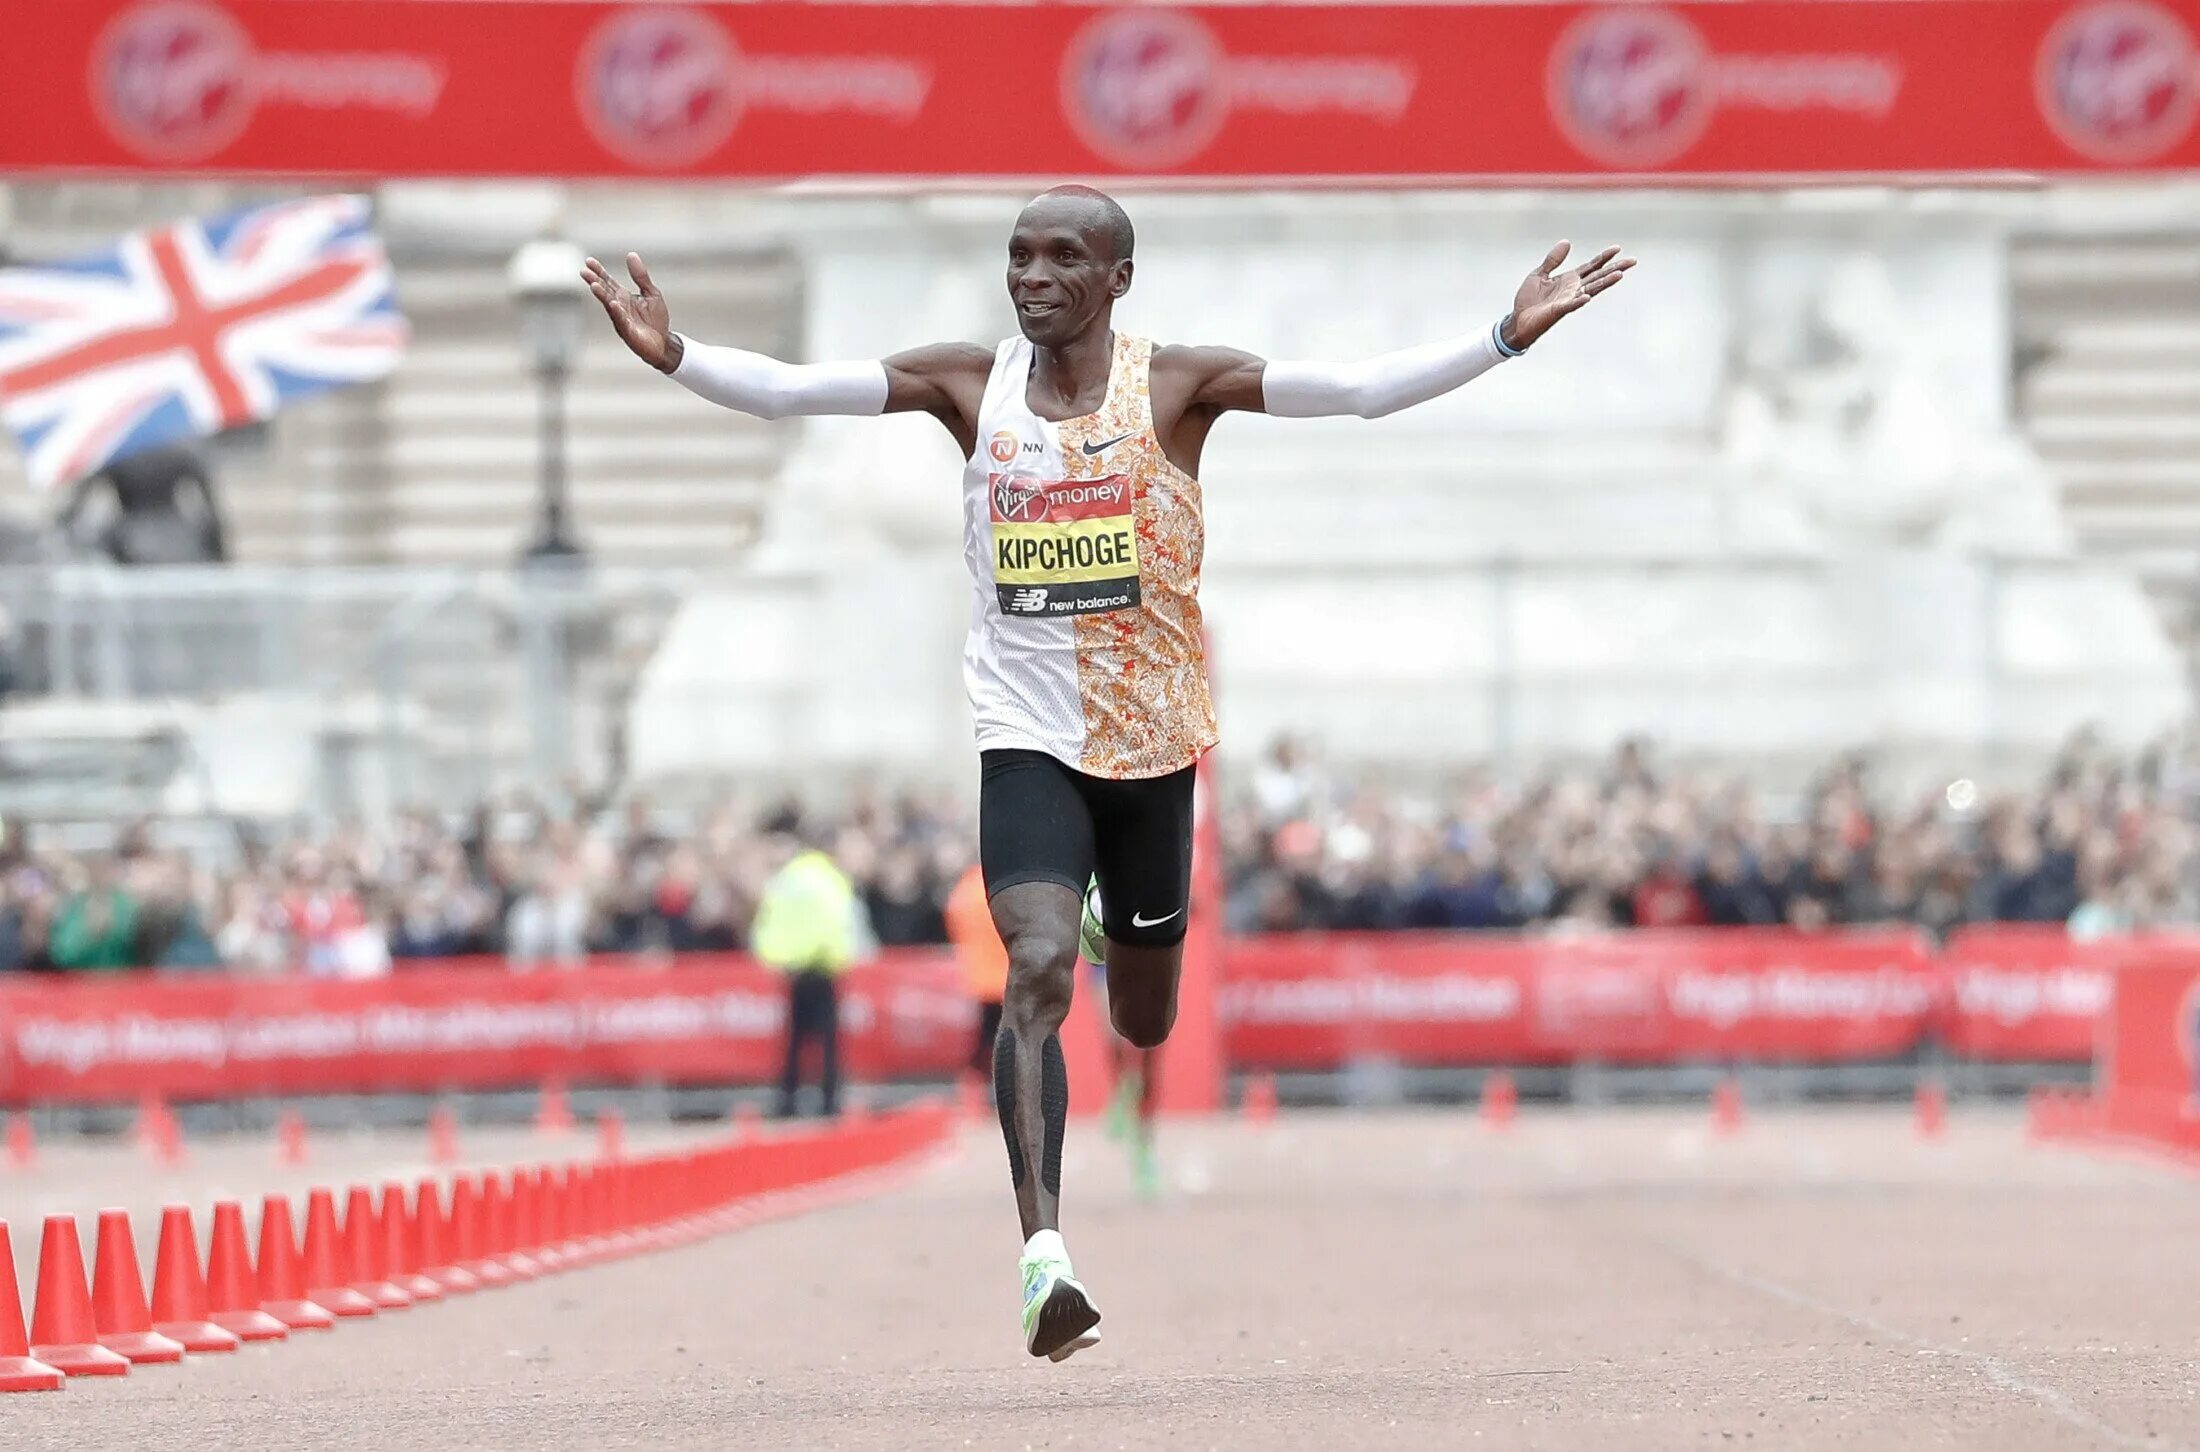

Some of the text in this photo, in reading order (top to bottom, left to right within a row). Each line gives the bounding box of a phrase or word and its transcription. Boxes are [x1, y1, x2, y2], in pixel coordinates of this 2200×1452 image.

[1022, 442, 1044, 454] NN
[1050, 483, 1123, 506] money
[999, 531, 1132, 570] KIPCHOGE
[1049, 601, 1075, 612] new
